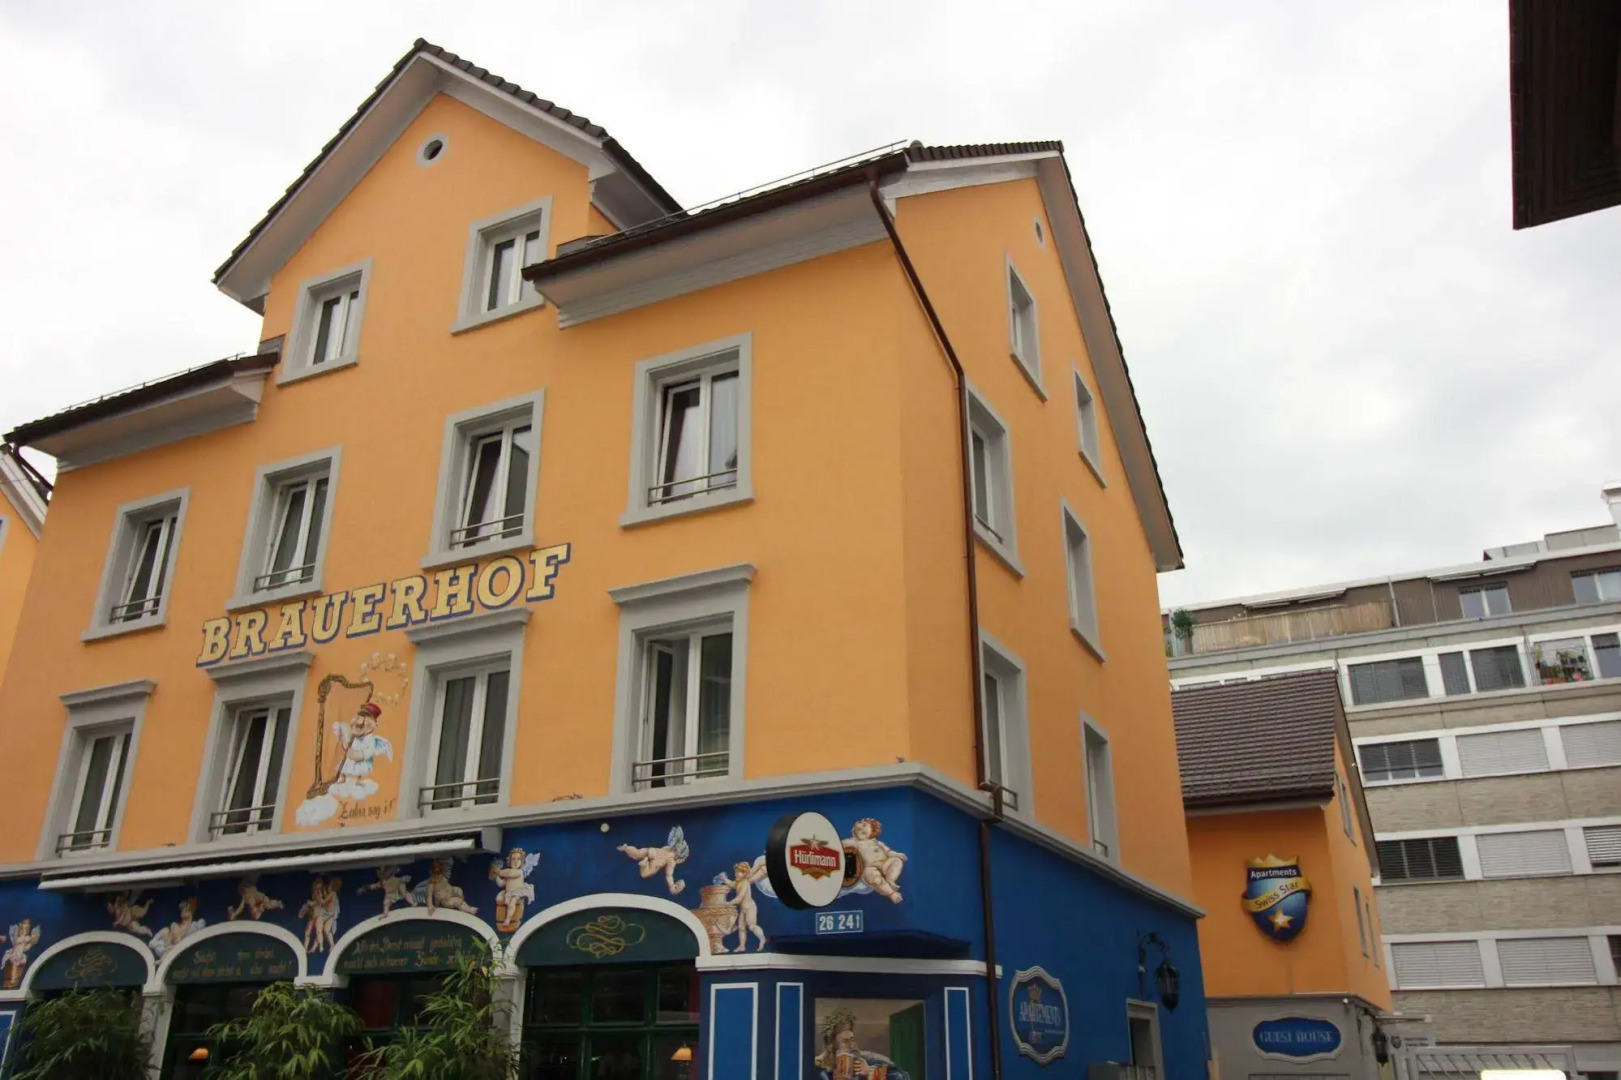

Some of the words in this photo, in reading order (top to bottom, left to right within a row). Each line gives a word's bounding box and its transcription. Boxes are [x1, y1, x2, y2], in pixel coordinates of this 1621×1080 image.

[196, 543, 571, 667] BRAUERHOF
[794, 849, 837, 867] Hürlimann
[1250, 868, 1297, 879] Apartments
[1255, 893, 1280, 909] Swiss
[1279, 881, 1299, 895] Star
[819, 915, 834, 931] 26
[838, 914, 854, 930] 24
[1260, 1030, 1292, 1043] GUEST
[1295, 1030, 1334, 1043] HOUSE
